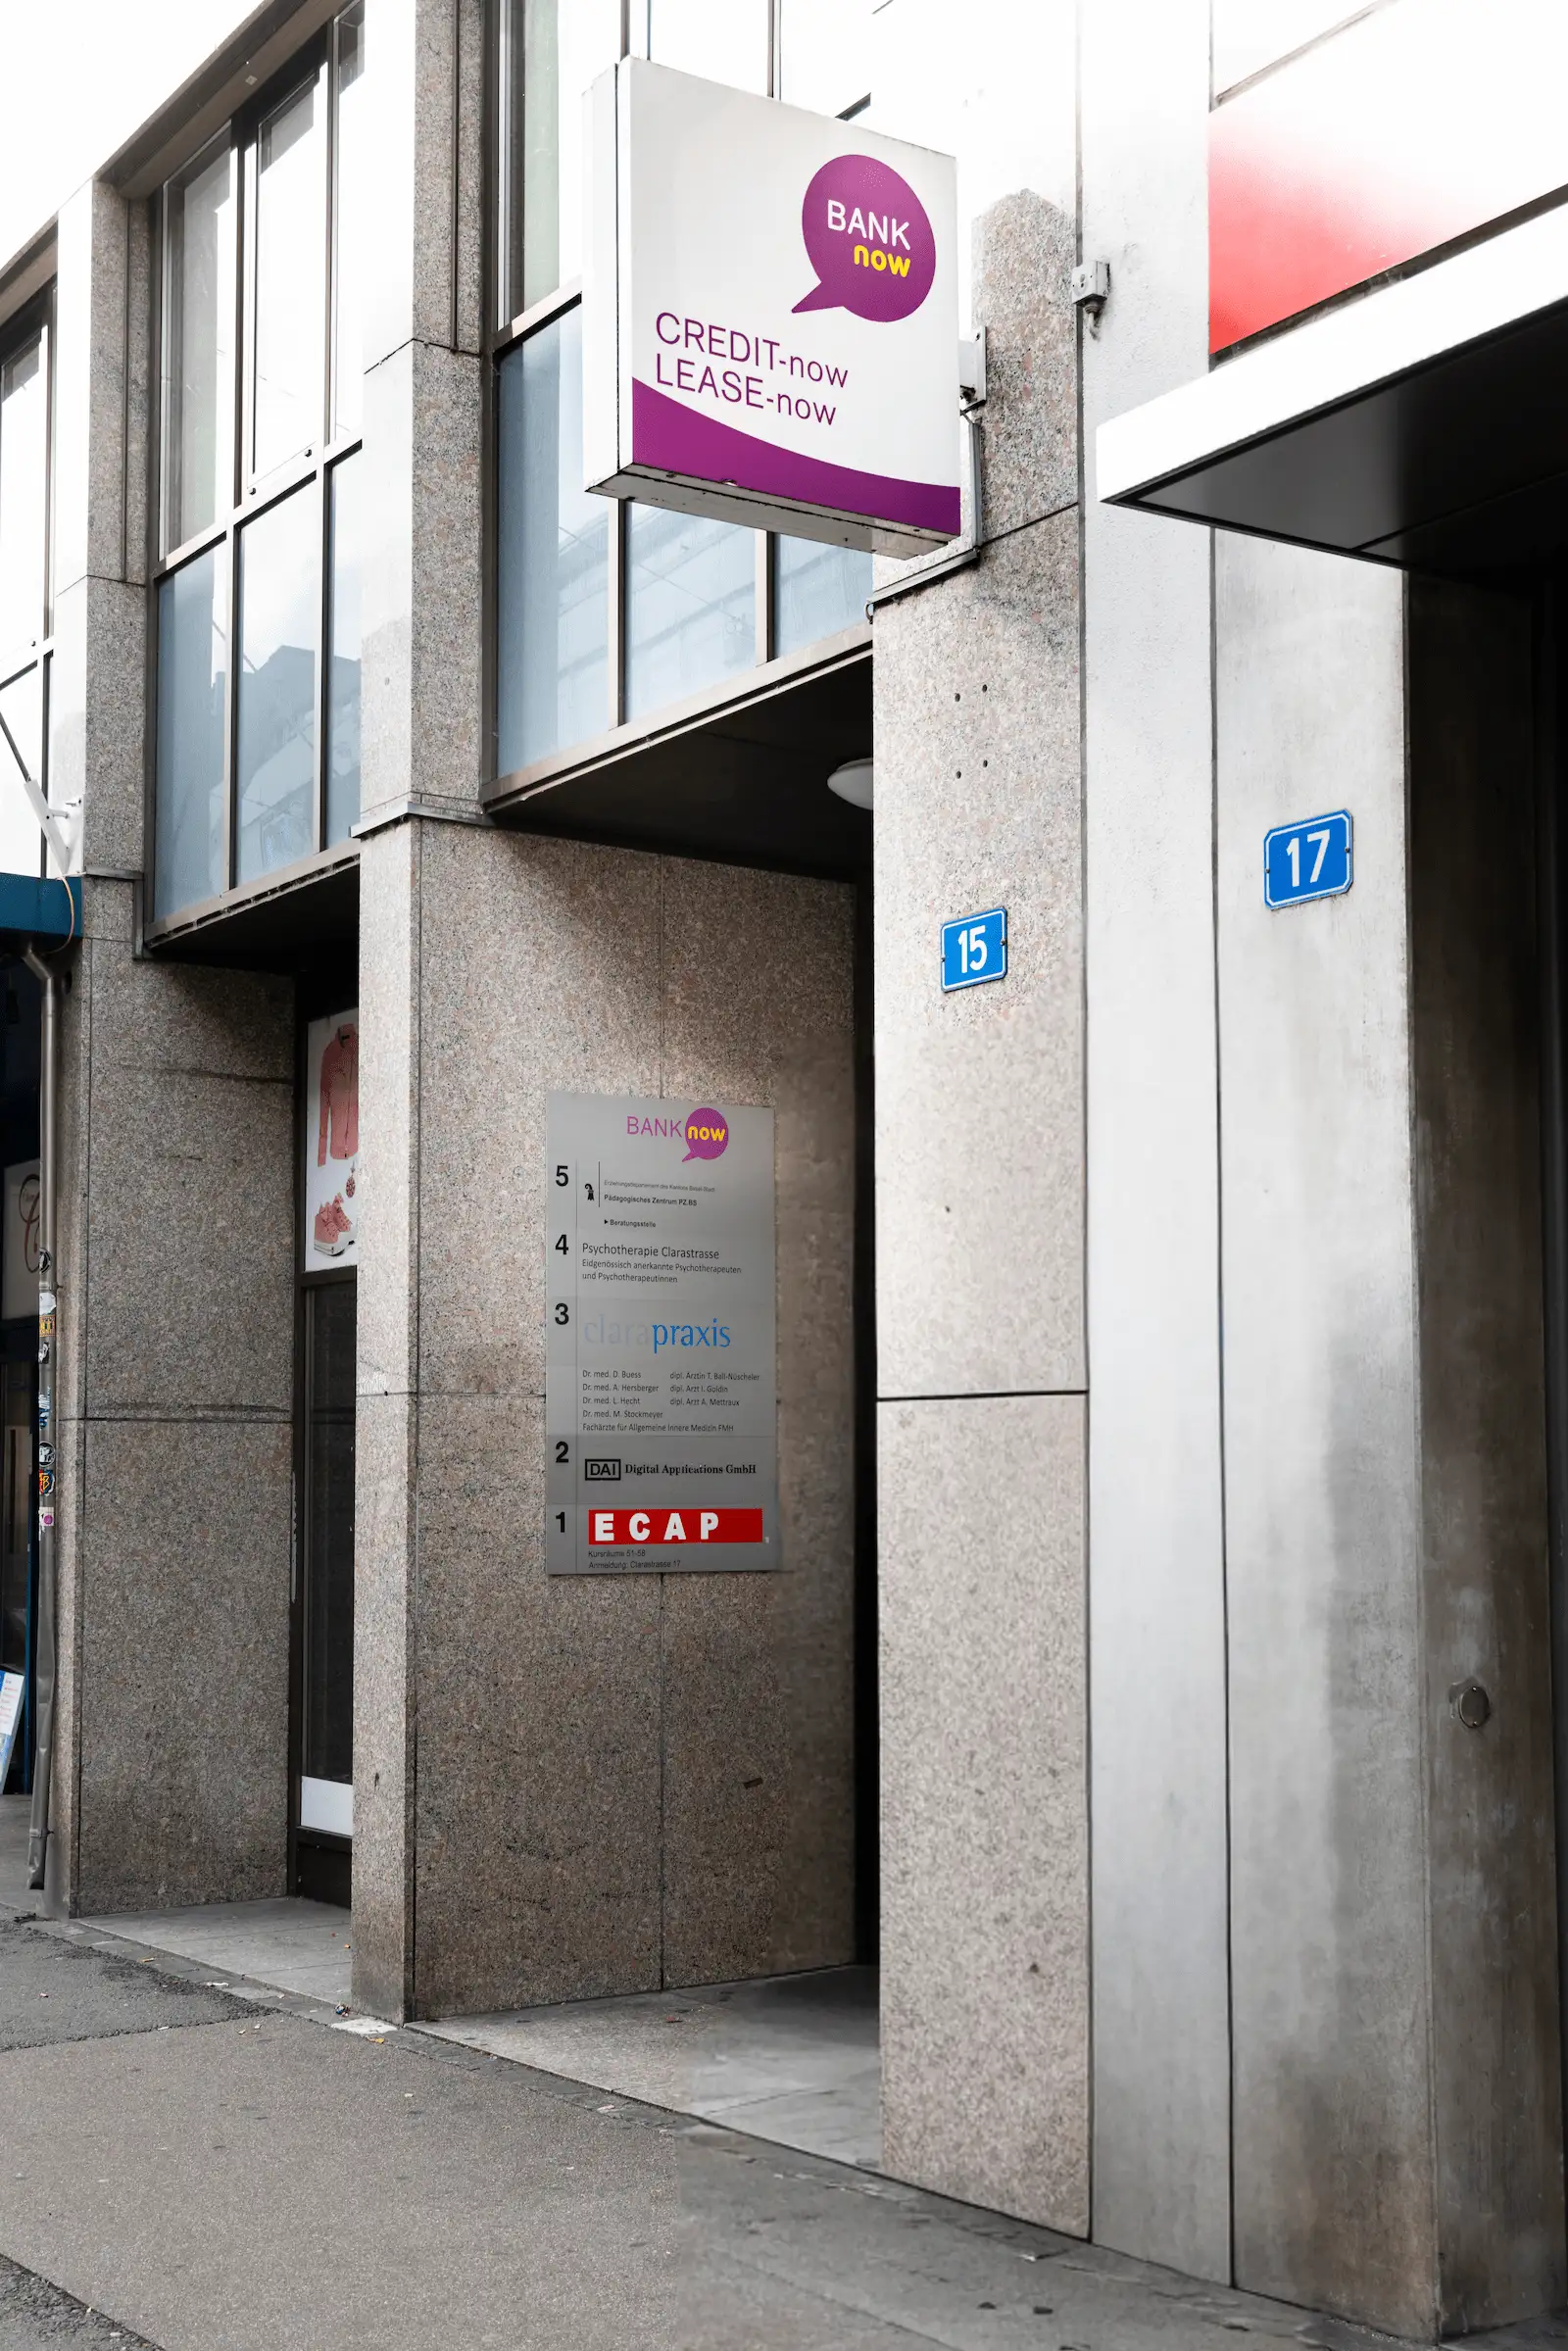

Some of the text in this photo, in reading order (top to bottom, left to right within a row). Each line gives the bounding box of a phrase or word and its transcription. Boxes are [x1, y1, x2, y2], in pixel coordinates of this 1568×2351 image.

[826, 199, 911, 251] BANK
[854, 244, 910, 278] now
[656, 312, 849, 388] CREDIT-now
[656, 353, 836, 425] LEASE-now
[1286, 828, 1331, 888] 17
[957, 925, 988, 974] 15
[626, 1115, 726, 1142] BANK now
[556, 1165, 569, 1187] 5
[604, 1194, 651, 1203] Pädagogisches
[610, 1219, 657, 1228] Beratungsstelle
[555, 1234, 568, 1255] 4
[582, 1243, 719, 1259] Psychotherapie Clarastrasse
[582, 1259, 742, 1274] Eidgenössisch anerkannte Psychotherapeuten
[599, 1273, 678, 1284] Psychotherapeutinnen
[555, 1303, 569, 1325] 3
[621, 1384, 659, 1393] Hersberger
[623, 1410, 662, 1419] Stockmeyer
[629, 1423, 666, 1433] Allgemeine
[556, 1441, 569, 1463] 2
[590, 1463, 757, 1476] DAI Digital Applications GmbH
[556, 1511, 565, 1533] 1
[594, 1512, 719, 1542] ECAP
[630, 1560, 670, 1569] Clarastrasse
[673, 1559, 681, 1568] 17
